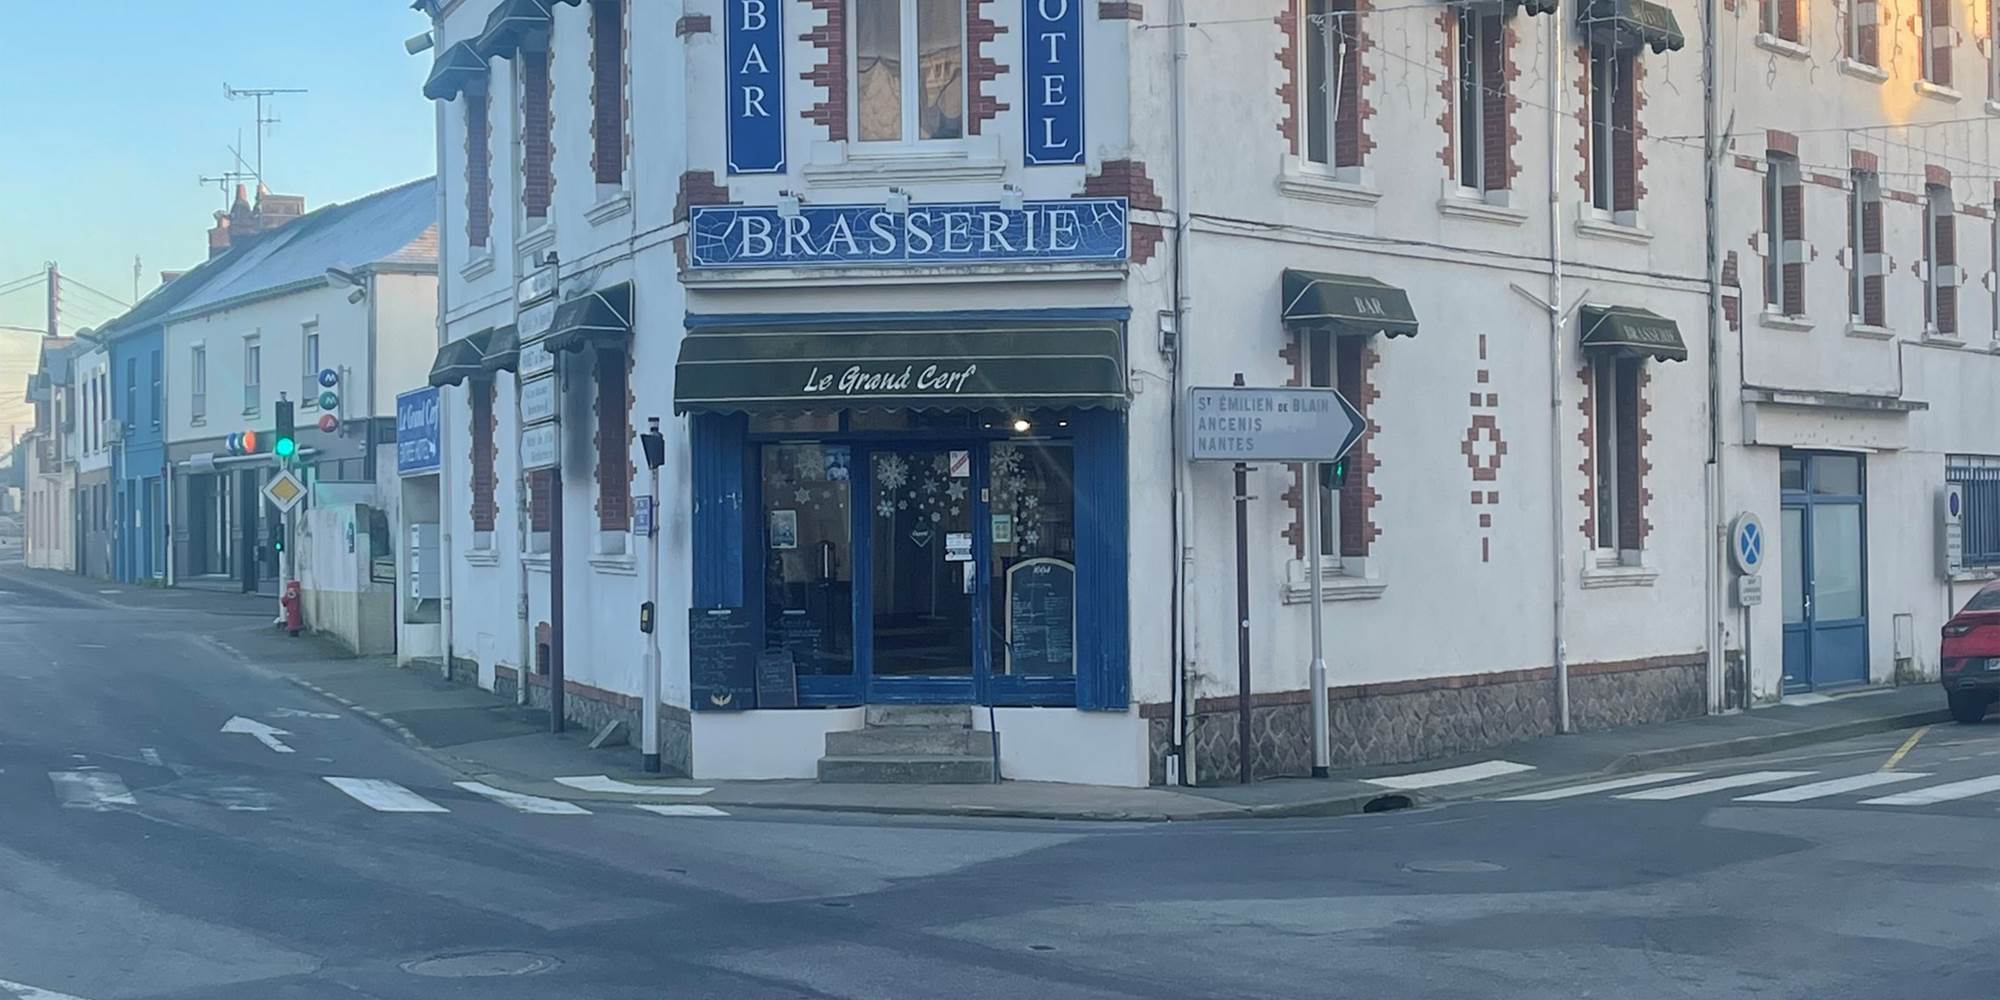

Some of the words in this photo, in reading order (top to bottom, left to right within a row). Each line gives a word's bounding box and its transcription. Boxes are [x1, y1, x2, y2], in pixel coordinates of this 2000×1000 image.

[740, 0, 770, 117] BAR
[738, 209, 1080, 258] BRASSERIE
[1353, 296, 1386, 316] BAR
[804, 367, 833, 392] Le
[838, 365, 912, 394] Grand
[917, 364, 977, 393] Cerf
[1220, 396, 1273, 412] ÉMILIEN
[1293, 399, 1329, 413] BLAIN
[1198, 417, 1263, 432] ANCENIS
[1198, 437, 1254, 451] NANTES
